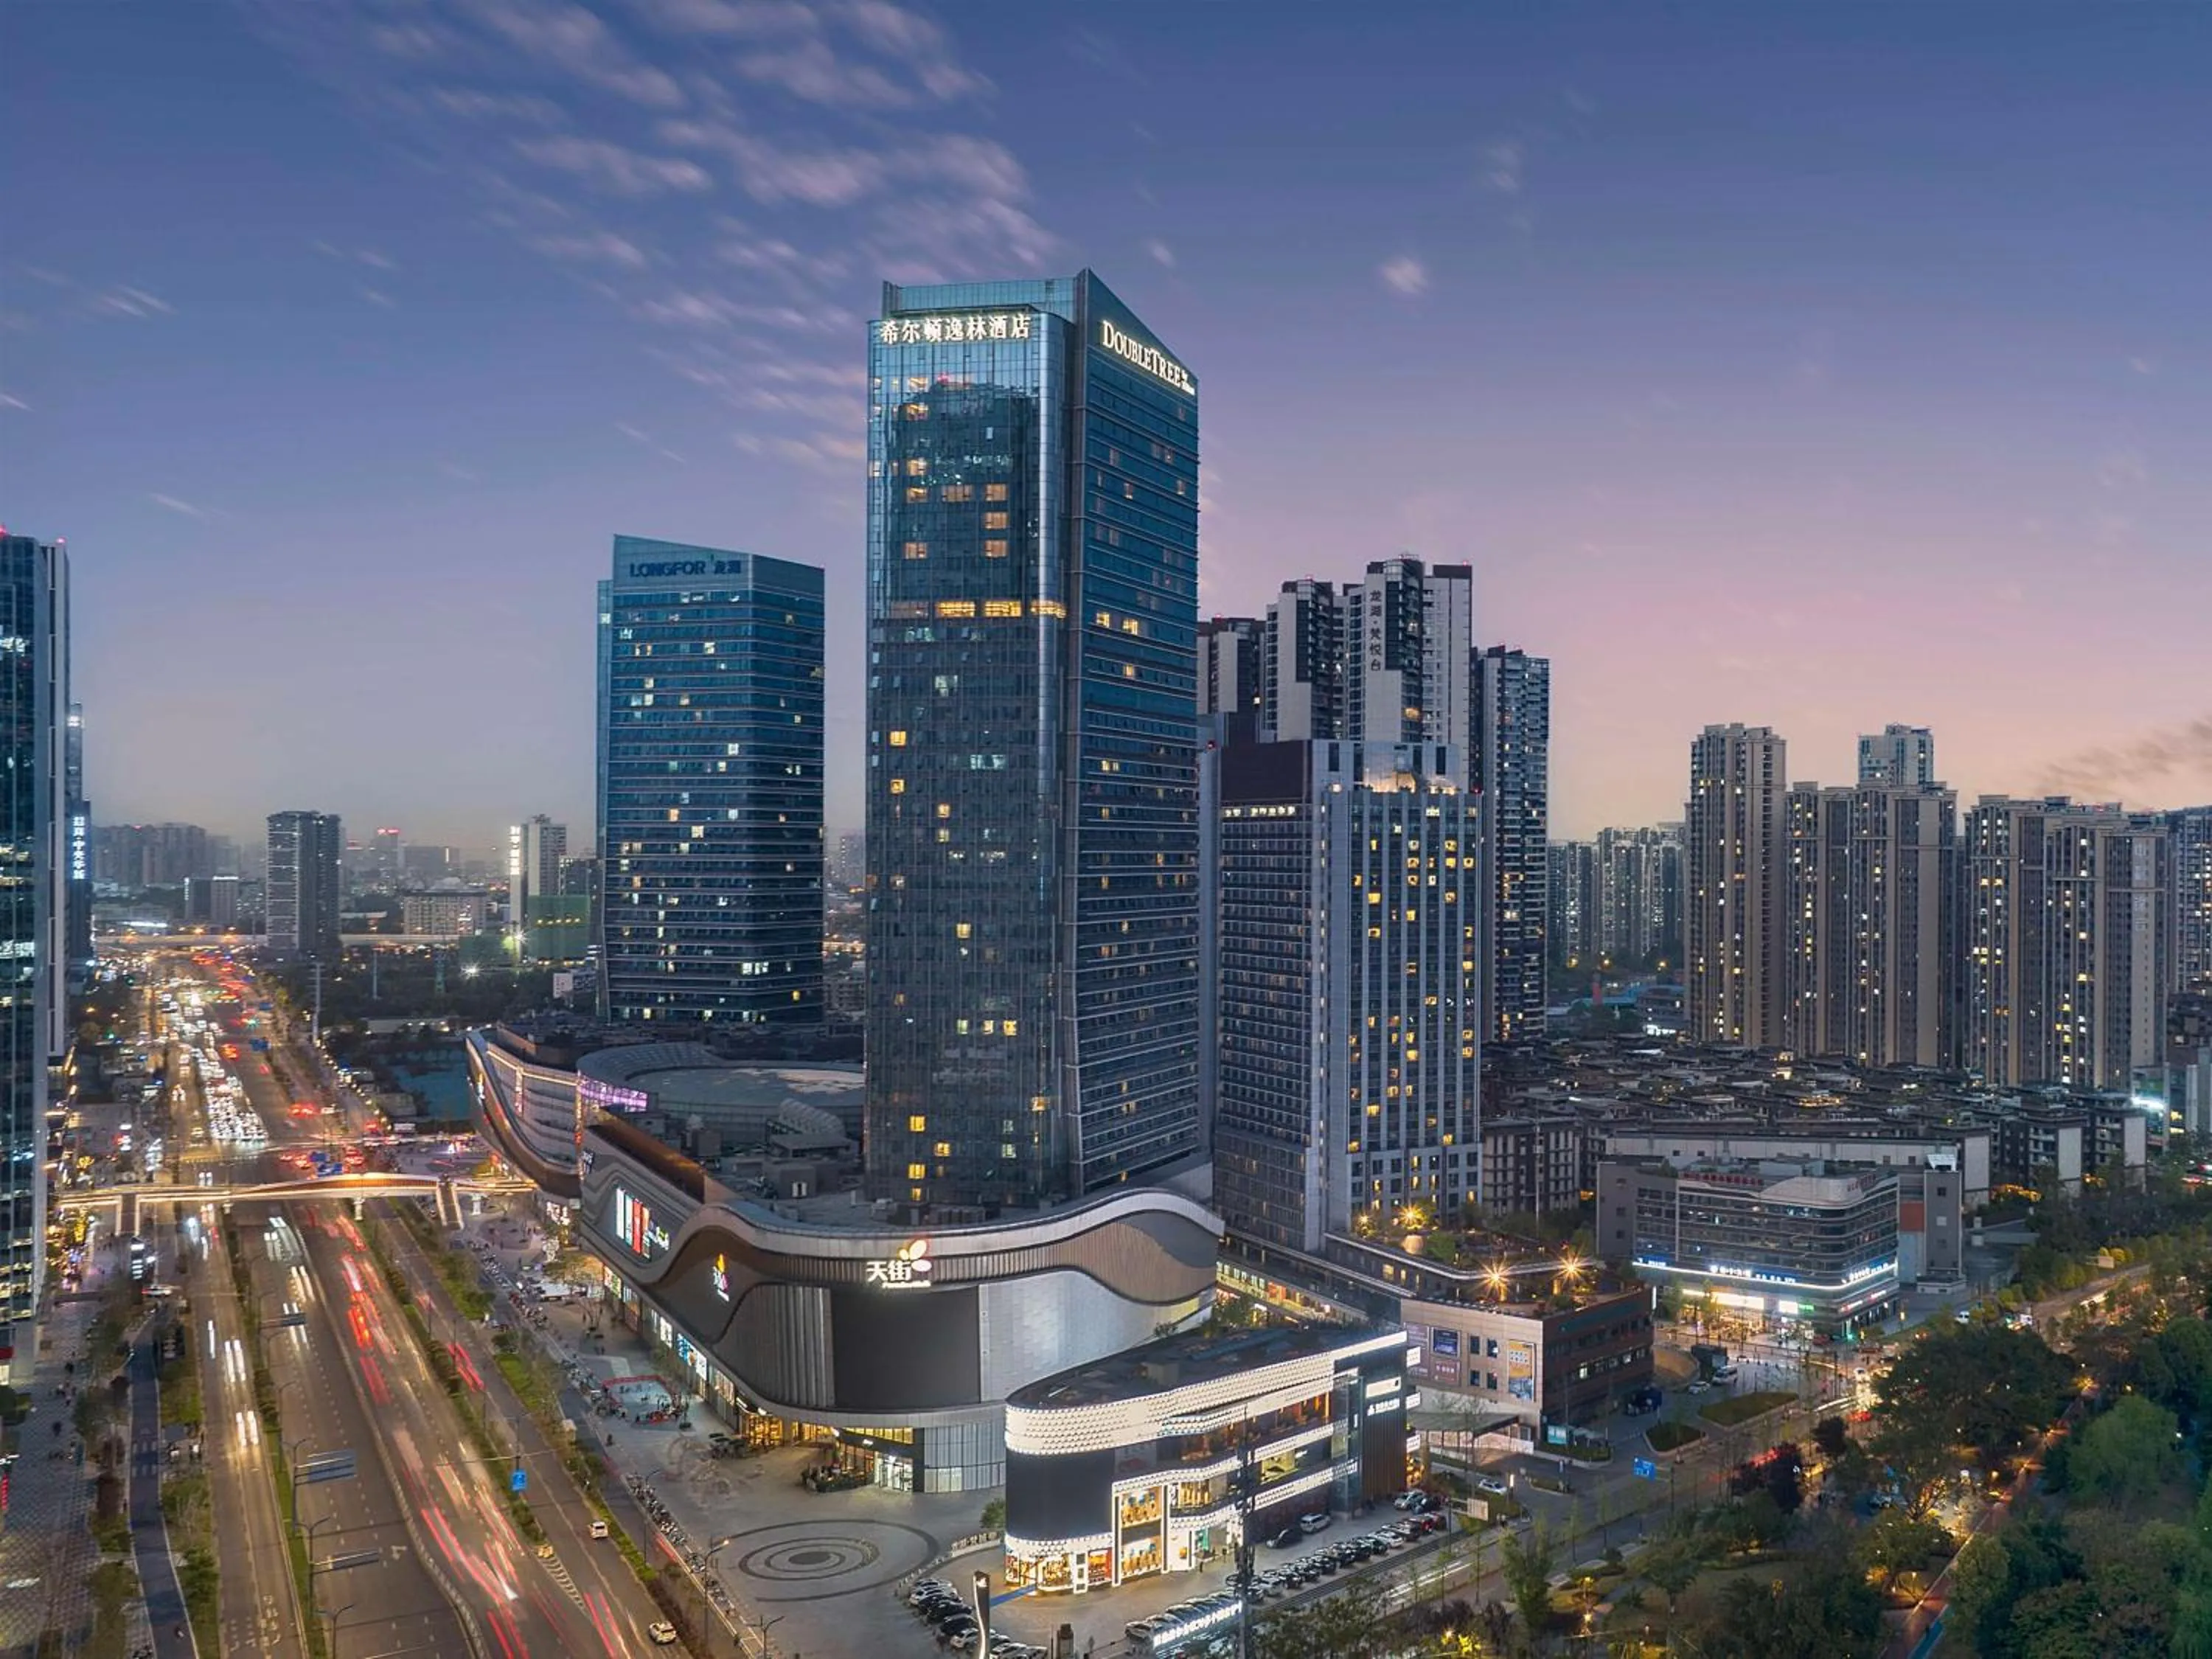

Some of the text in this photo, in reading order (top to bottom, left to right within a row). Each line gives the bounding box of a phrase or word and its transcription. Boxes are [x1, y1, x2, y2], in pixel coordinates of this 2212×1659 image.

[880, 313, 1032, 344] 希尔顿逸林酒店
[629, 560, 706, 577] LONGFOR
[866, 1260, 911, 1282] 天街
